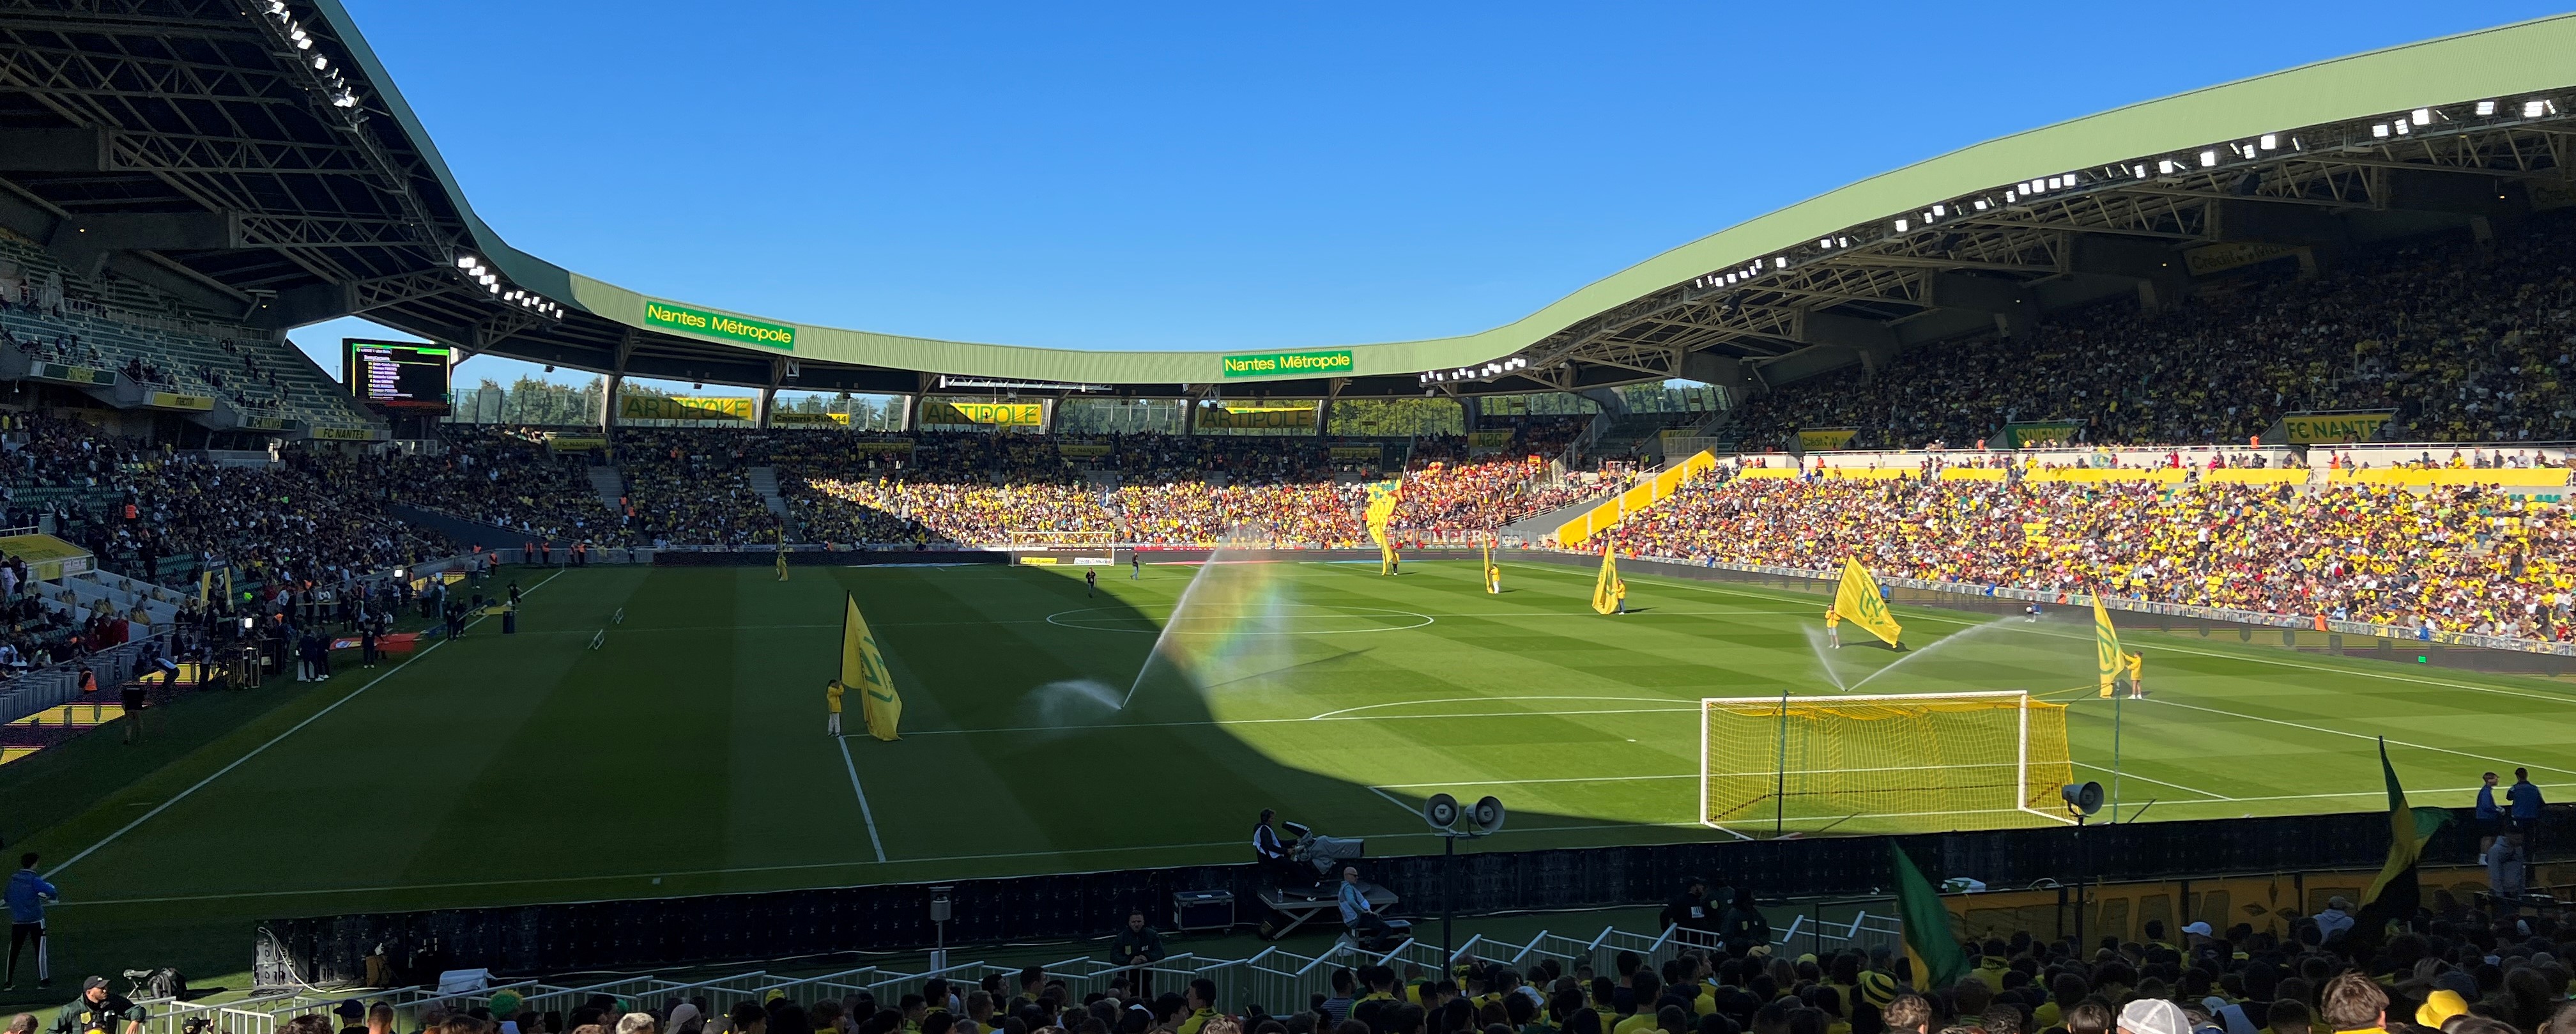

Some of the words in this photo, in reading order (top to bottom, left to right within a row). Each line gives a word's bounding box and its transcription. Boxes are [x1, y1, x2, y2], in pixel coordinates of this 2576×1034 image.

[648, 305, 706, 328] Nantes
[712, 317, 792, 343] Métropole
[1225, 359, 1275, 372] Nantes
[1280, 353, 1350, 369] Métropole
[625, 399, 748, 418] ARTIPOLE
[926, 405, 1039, 424] ARTIPOLE
[1202, 408, 1309, 427] ARTIPOLE
[323, 429, 334, 438] FC
[335, 429, 365, 439] NANTES
[2287, 422, 2310, 439] FC
[2313, 420, 2379, 438] NANTE
